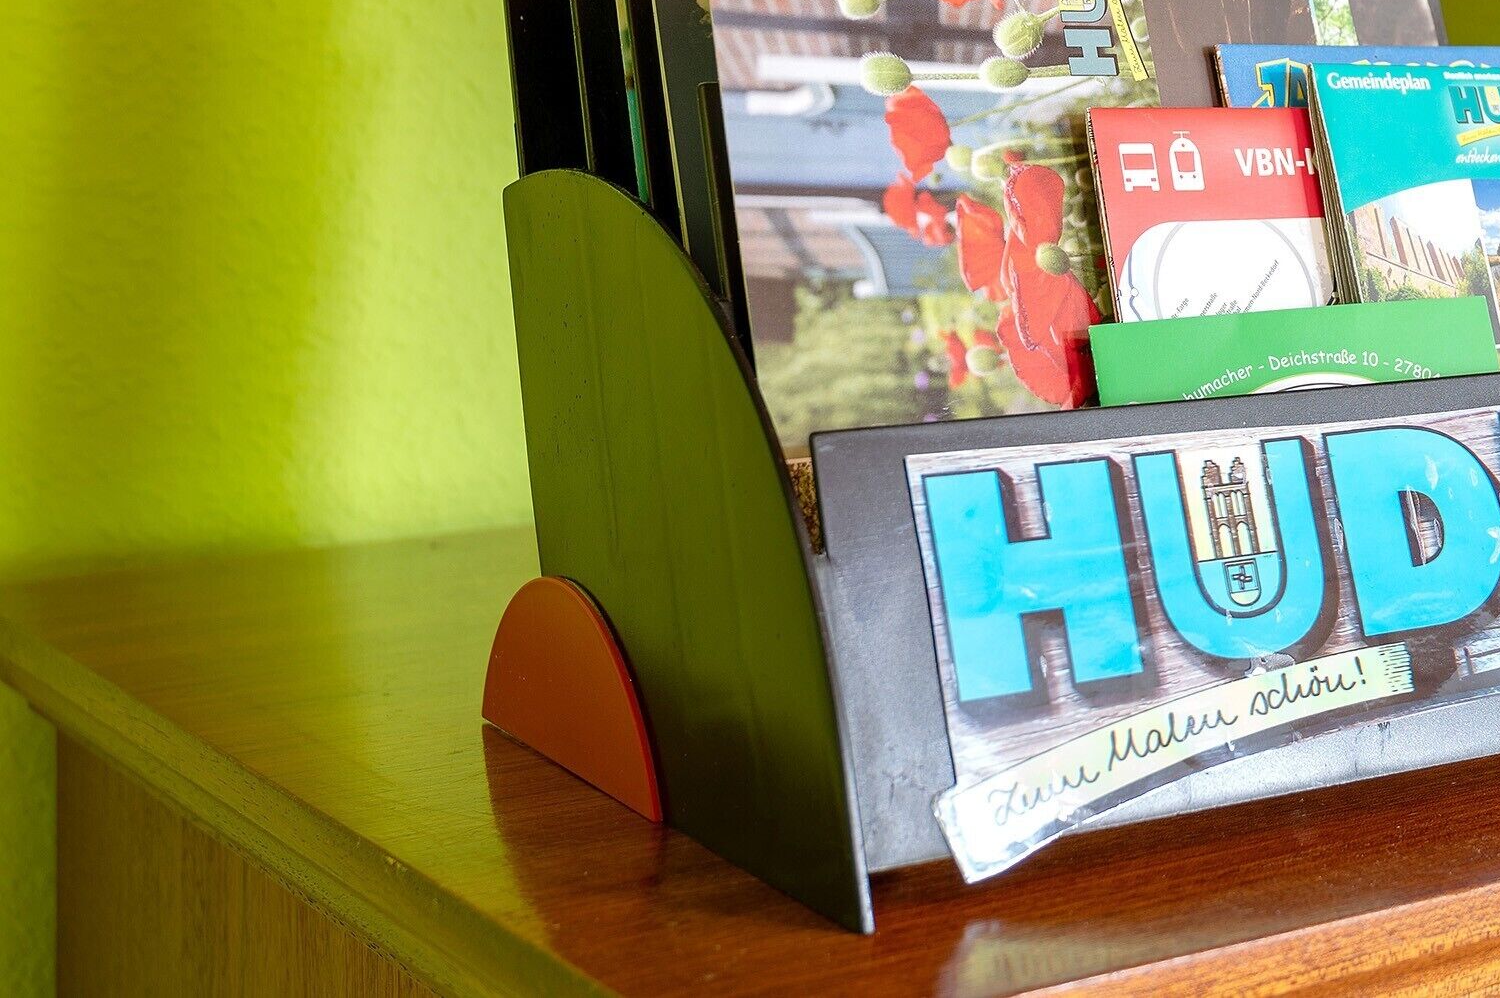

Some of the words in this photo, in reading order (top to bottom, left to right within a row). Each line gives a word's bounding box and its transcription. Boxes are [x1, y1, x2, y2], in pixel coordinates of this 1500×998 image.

[1326, 71, 1432, 96] Gemeindeplan
[1267, 348, 1357, 370] Deichstraße
[1362, 352, 1379, 367] 10
[986, 769, 1100, 826] Zum
[1108, 711, 1239, 772] Malen
[1250, 655, 1368, 716] schön!
